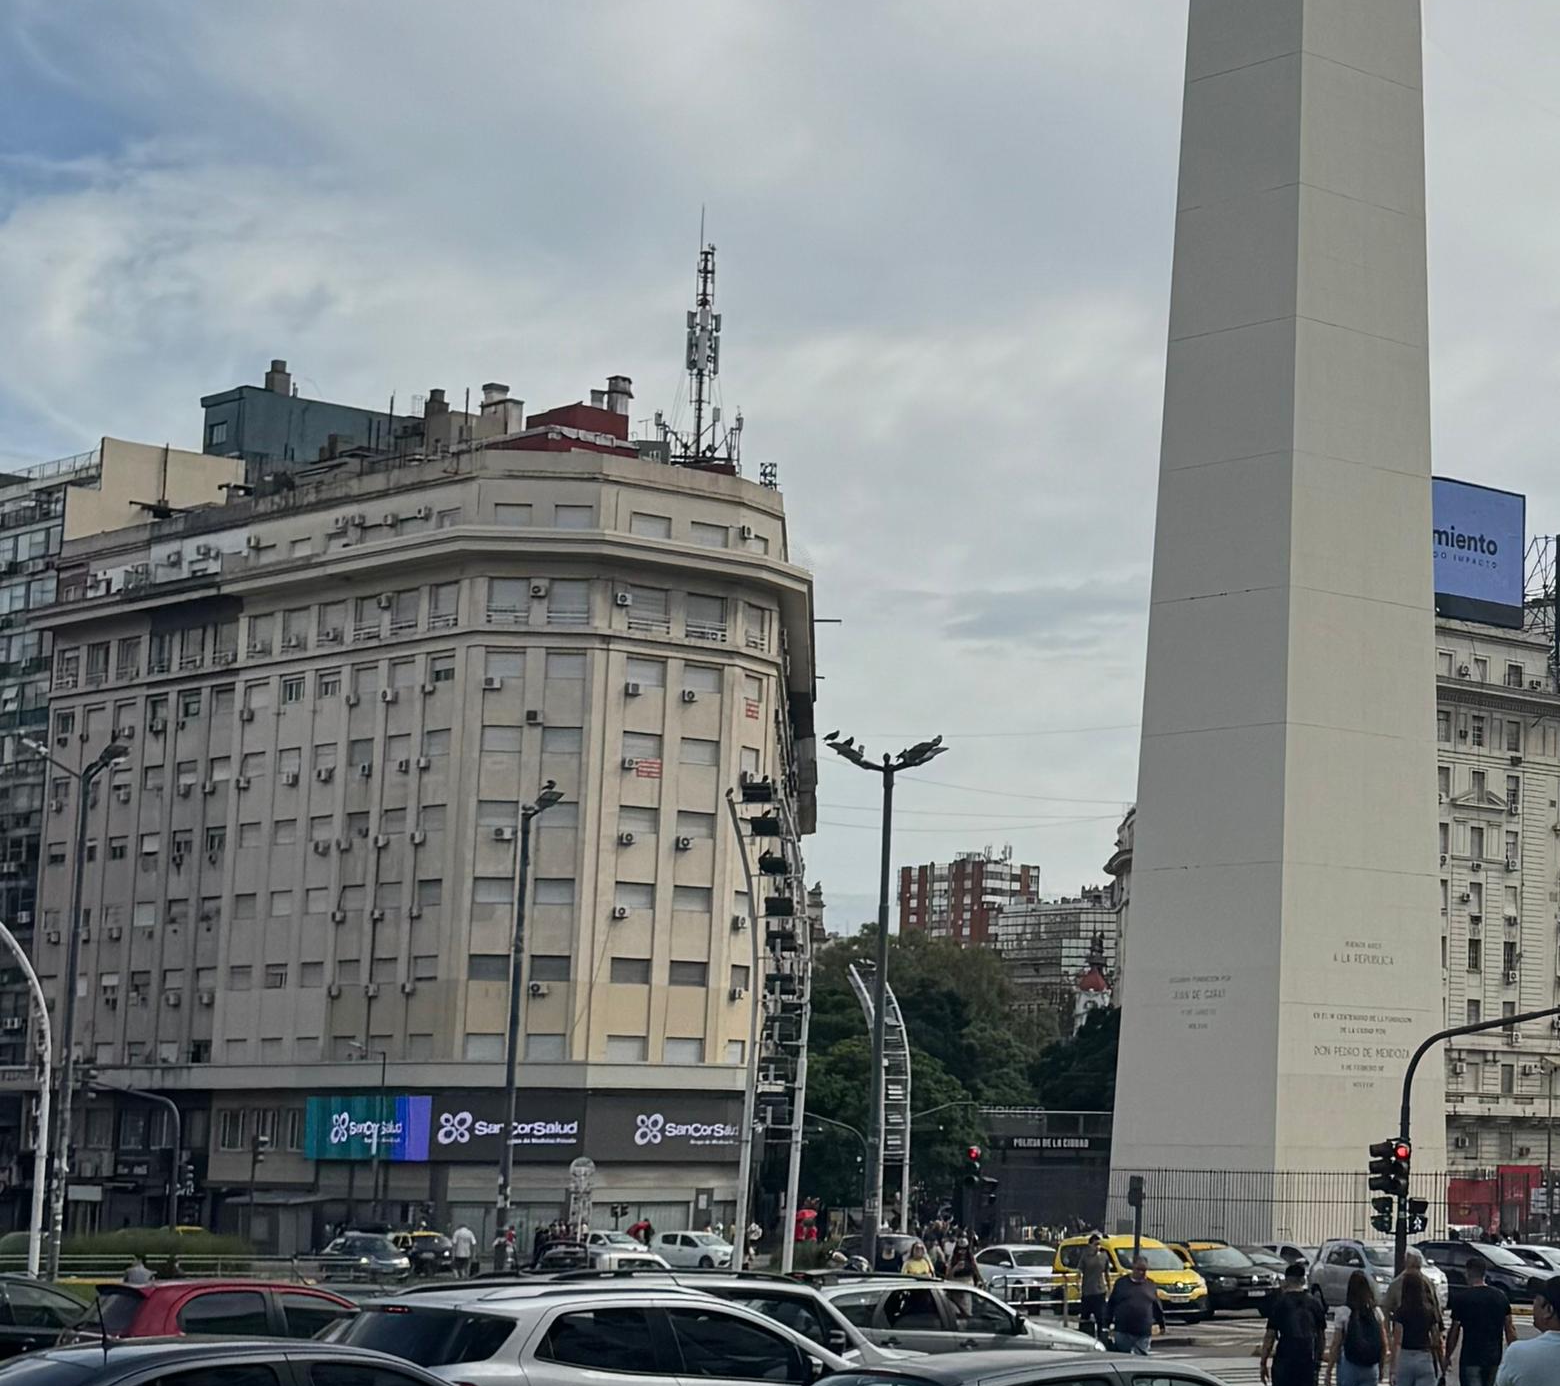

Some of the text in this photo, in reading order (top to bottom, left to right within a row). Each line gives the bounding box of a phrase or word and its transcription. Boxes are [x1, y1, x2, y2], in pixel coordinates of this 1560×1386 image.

[1013, 1138, 1089, 1148] POLICIA DE LA CIUDAD
